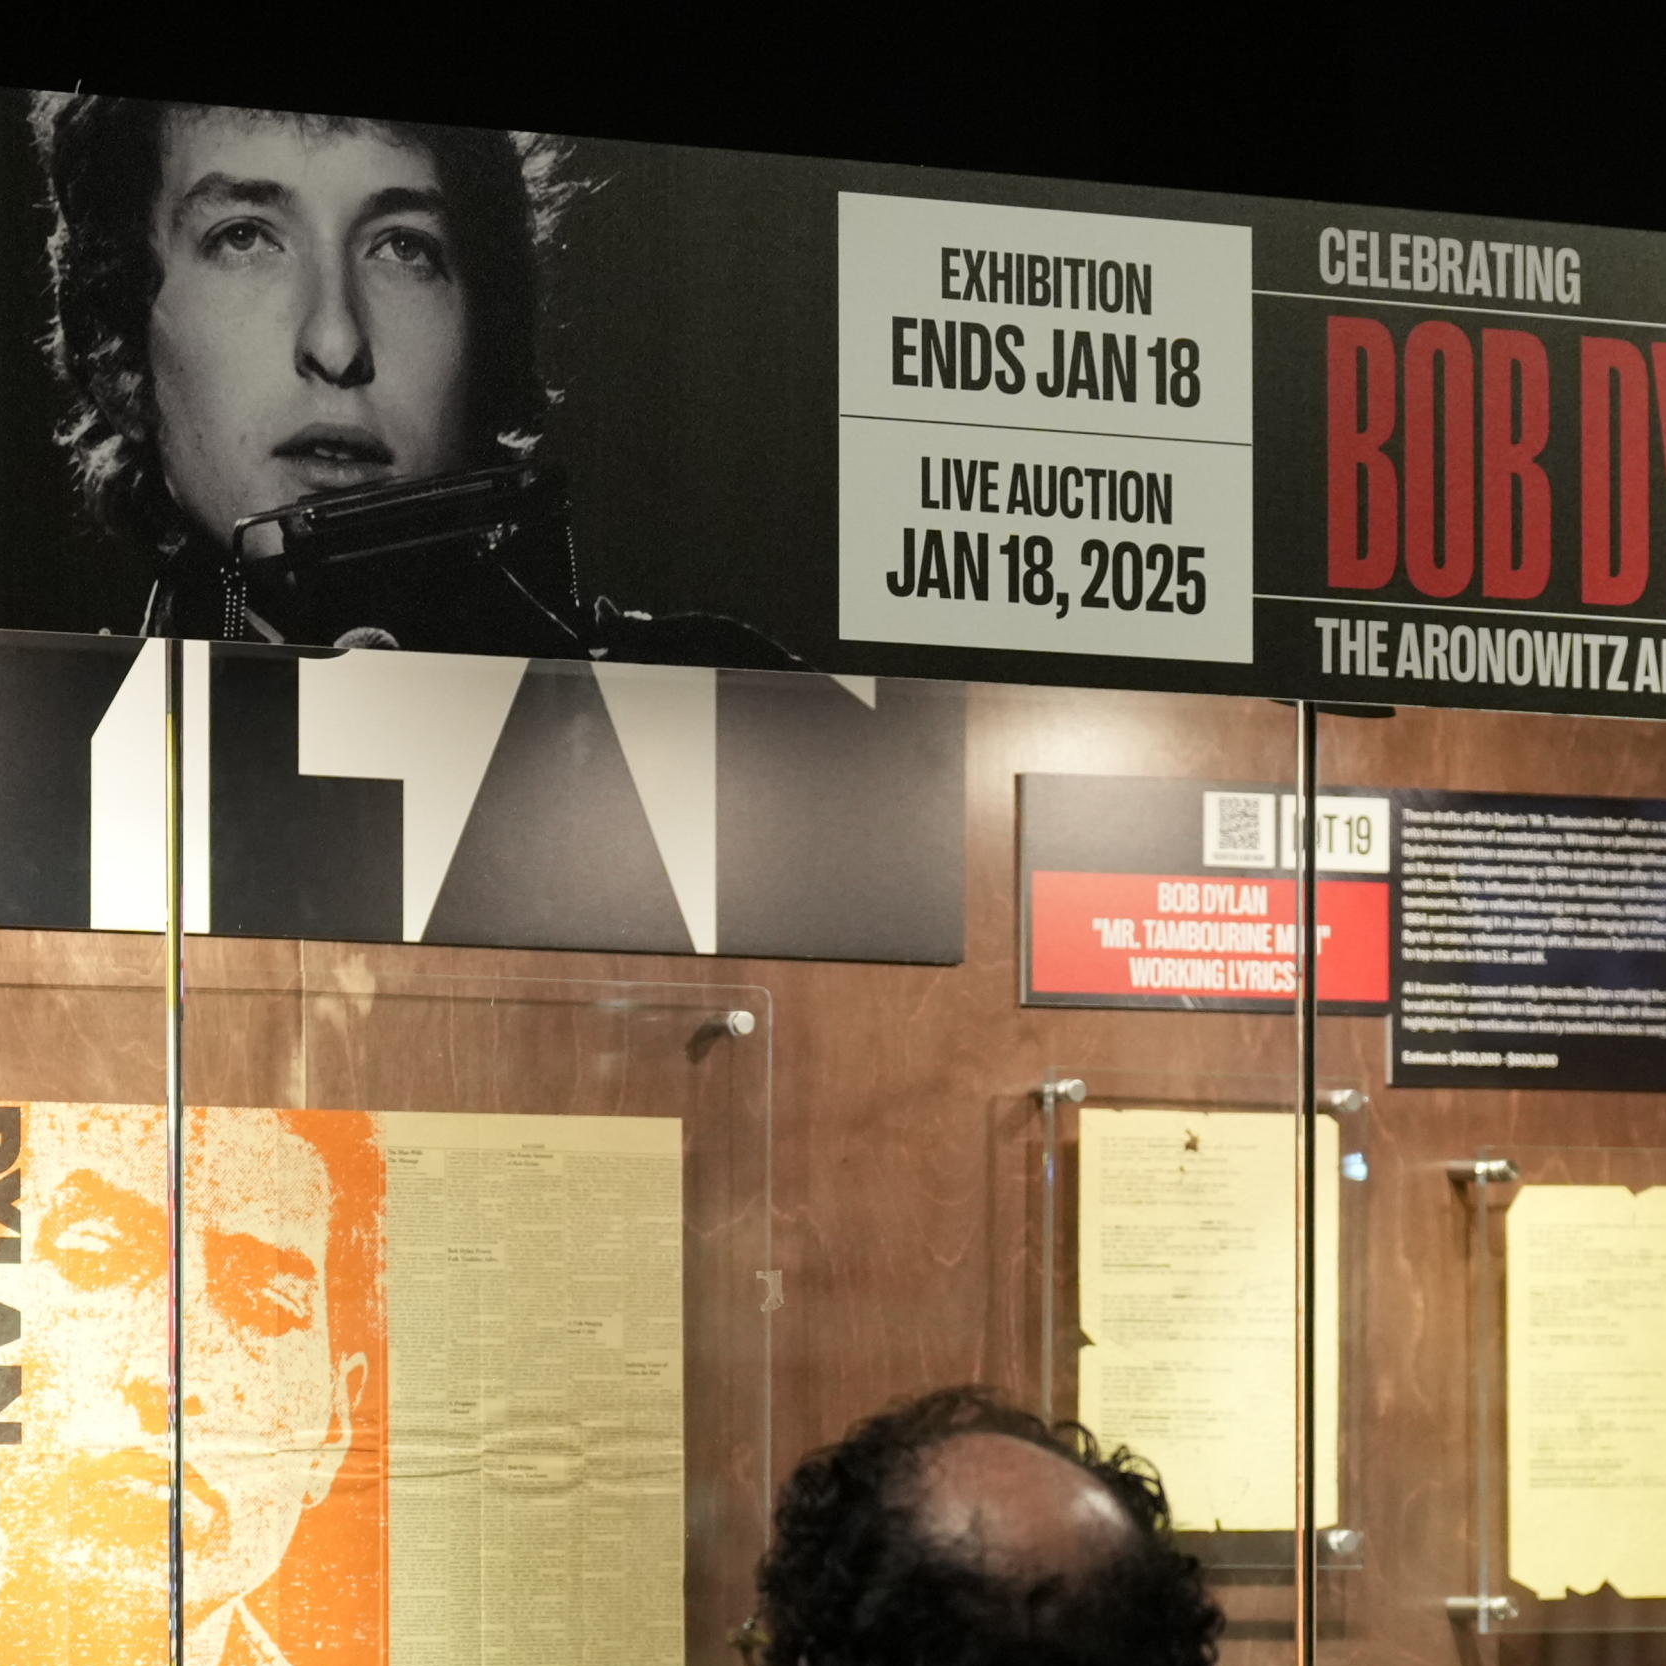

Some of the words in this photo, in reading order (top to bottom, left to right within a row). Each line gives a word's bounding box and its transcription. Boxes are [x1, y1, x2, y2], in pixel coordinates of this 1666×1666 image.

[941, 247, 1152, 315] EXHIBITION
[1318, 226, 1581, 305] CELEBRATING
[892, 315, 1026, 395] ENDS
[1036, 328, 1137, 403] JAN
[1147, 337, 1201, 408] 18
[921, 456, 999, 513] LIVE
[1007, 463, 1172, 525] AUCTION
[1327, 315, 1552, 600] BOB
[886, 527, 989, 602] JAN
[999, 534, 1069, 619] 18,
[1080, 538, 1206, 615] 2025
[1315, 617, 1388, 677] THE
[1395, 622, 1629, 691] ARONOWITZ
[1346, 815, 1372, 855] 19
[1158, 882, 1202, 914] BOB
[1203, 883, 1268, 916] DYLAN
[1143, 919, 1272, 953] TAMBOURINE
[1129, 957, 1226, 990] WORKING
[1228, 960, 1297, 992] LYRICS
